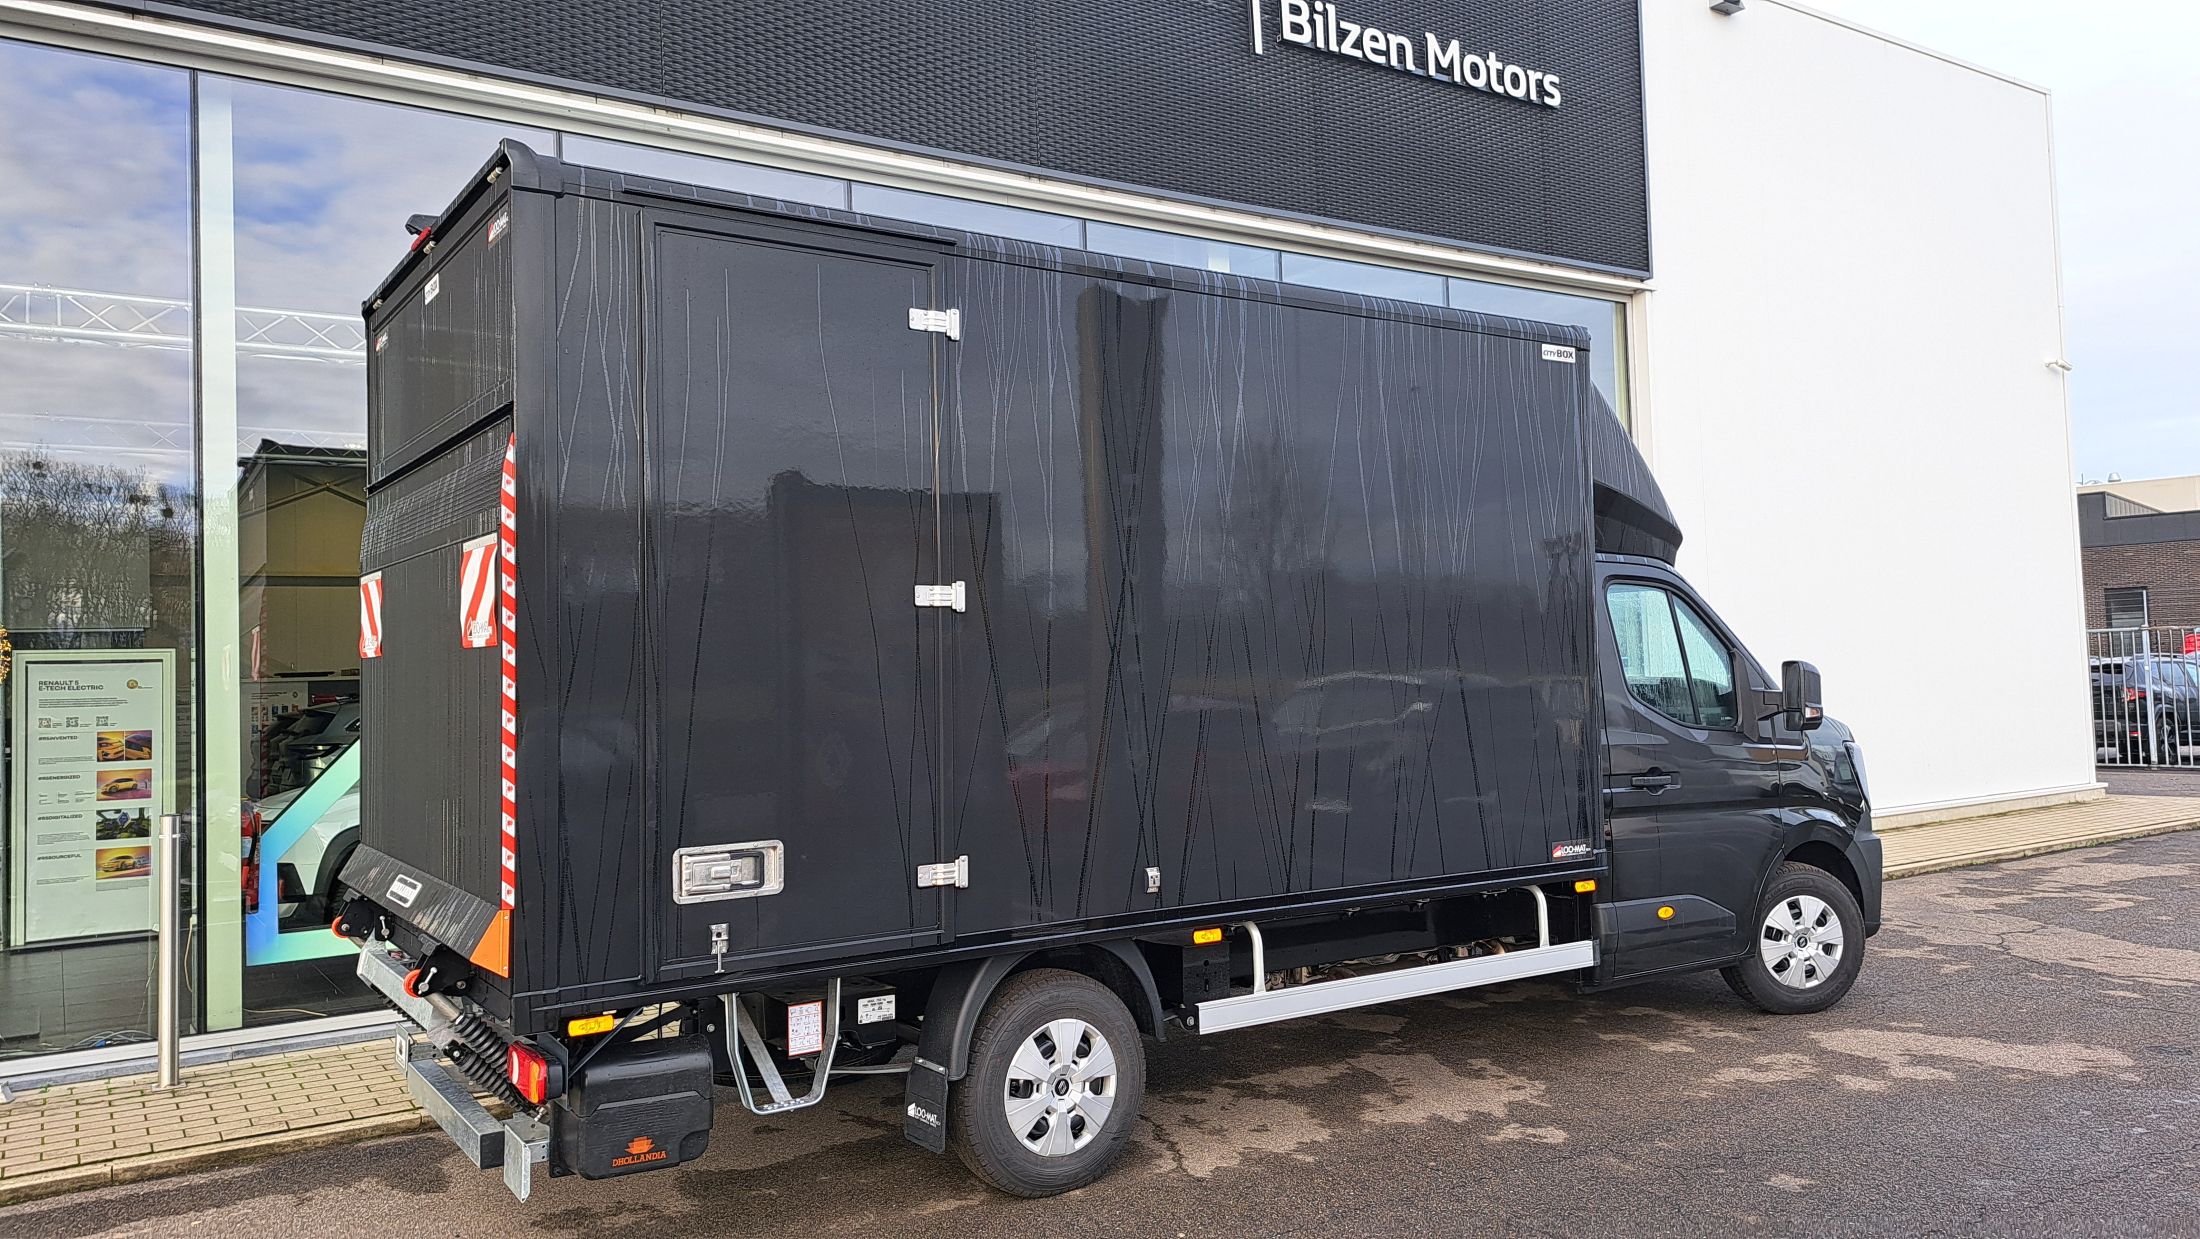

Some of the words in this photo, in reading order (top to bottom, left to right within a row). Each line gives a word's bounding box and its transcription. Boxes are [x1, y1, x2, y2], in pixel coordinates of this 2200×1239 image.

[1281, 0, 1415, 71] Bilzen
[1425, 32, 1562, 107] Motors
[612, 1151, 667, 1167] DHOLLANDIA
